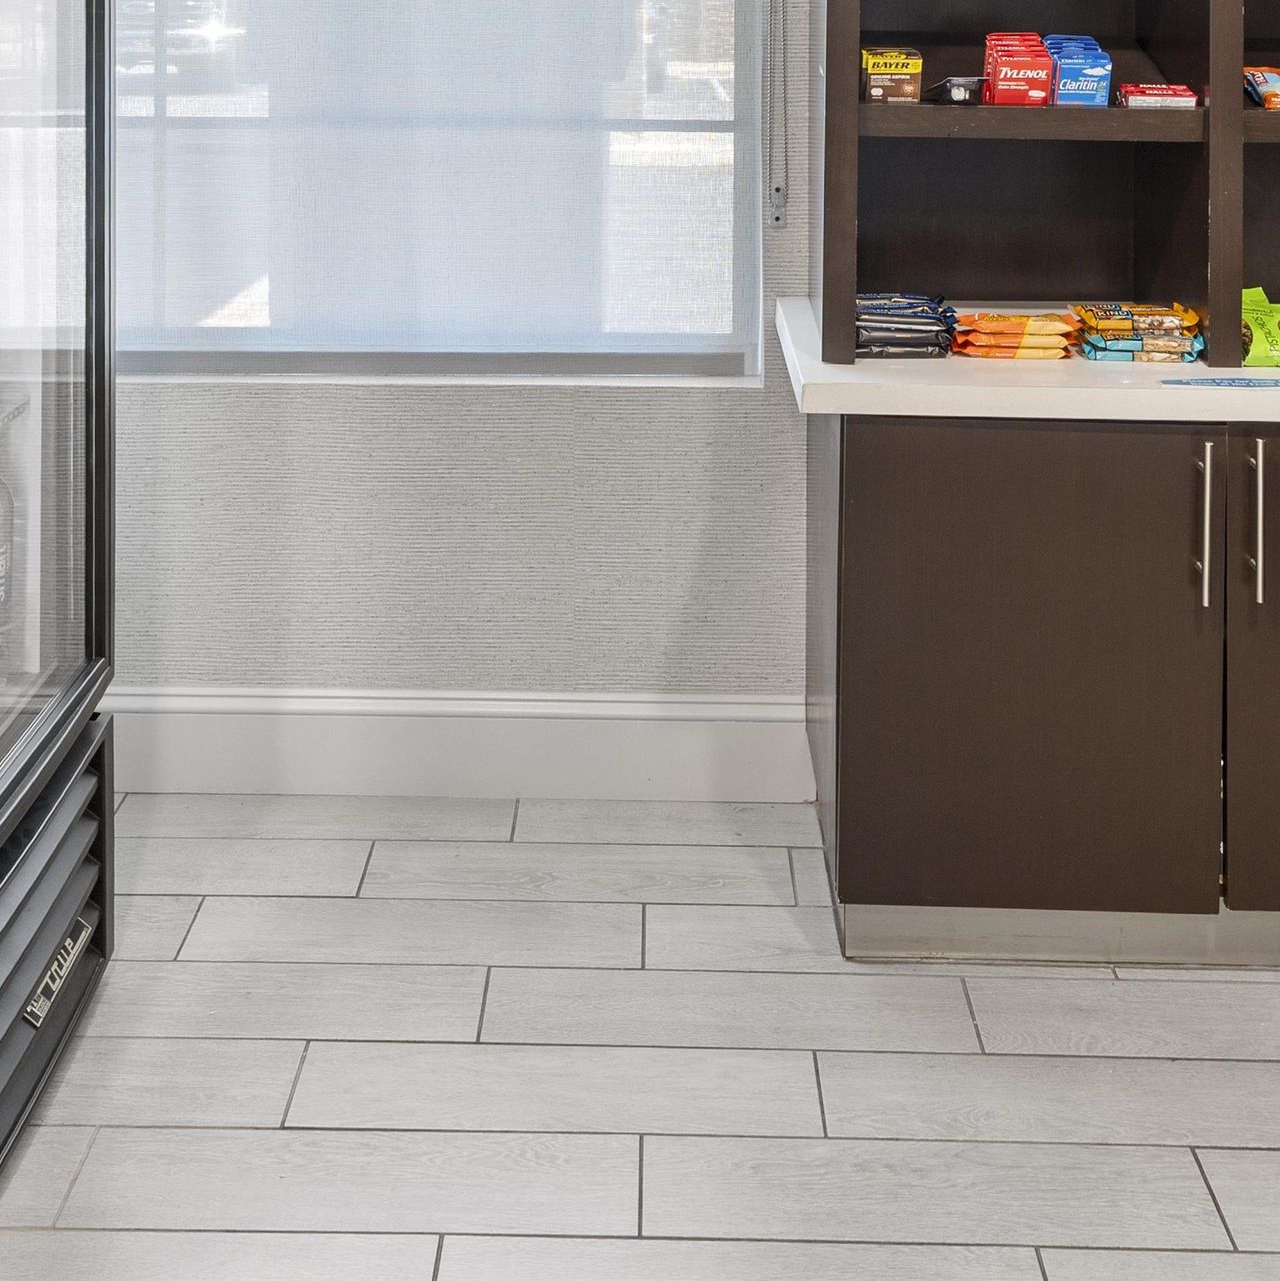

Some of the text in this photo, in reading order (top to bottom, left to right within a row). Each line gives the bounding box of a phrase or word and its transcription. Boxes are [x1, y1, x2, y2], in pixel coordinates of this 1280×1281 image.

[872, 61, 910, 69] BAYER
[999, 68, 1048, 79] TYLENOL
[1059, 79, 1097, 91] Claritin
